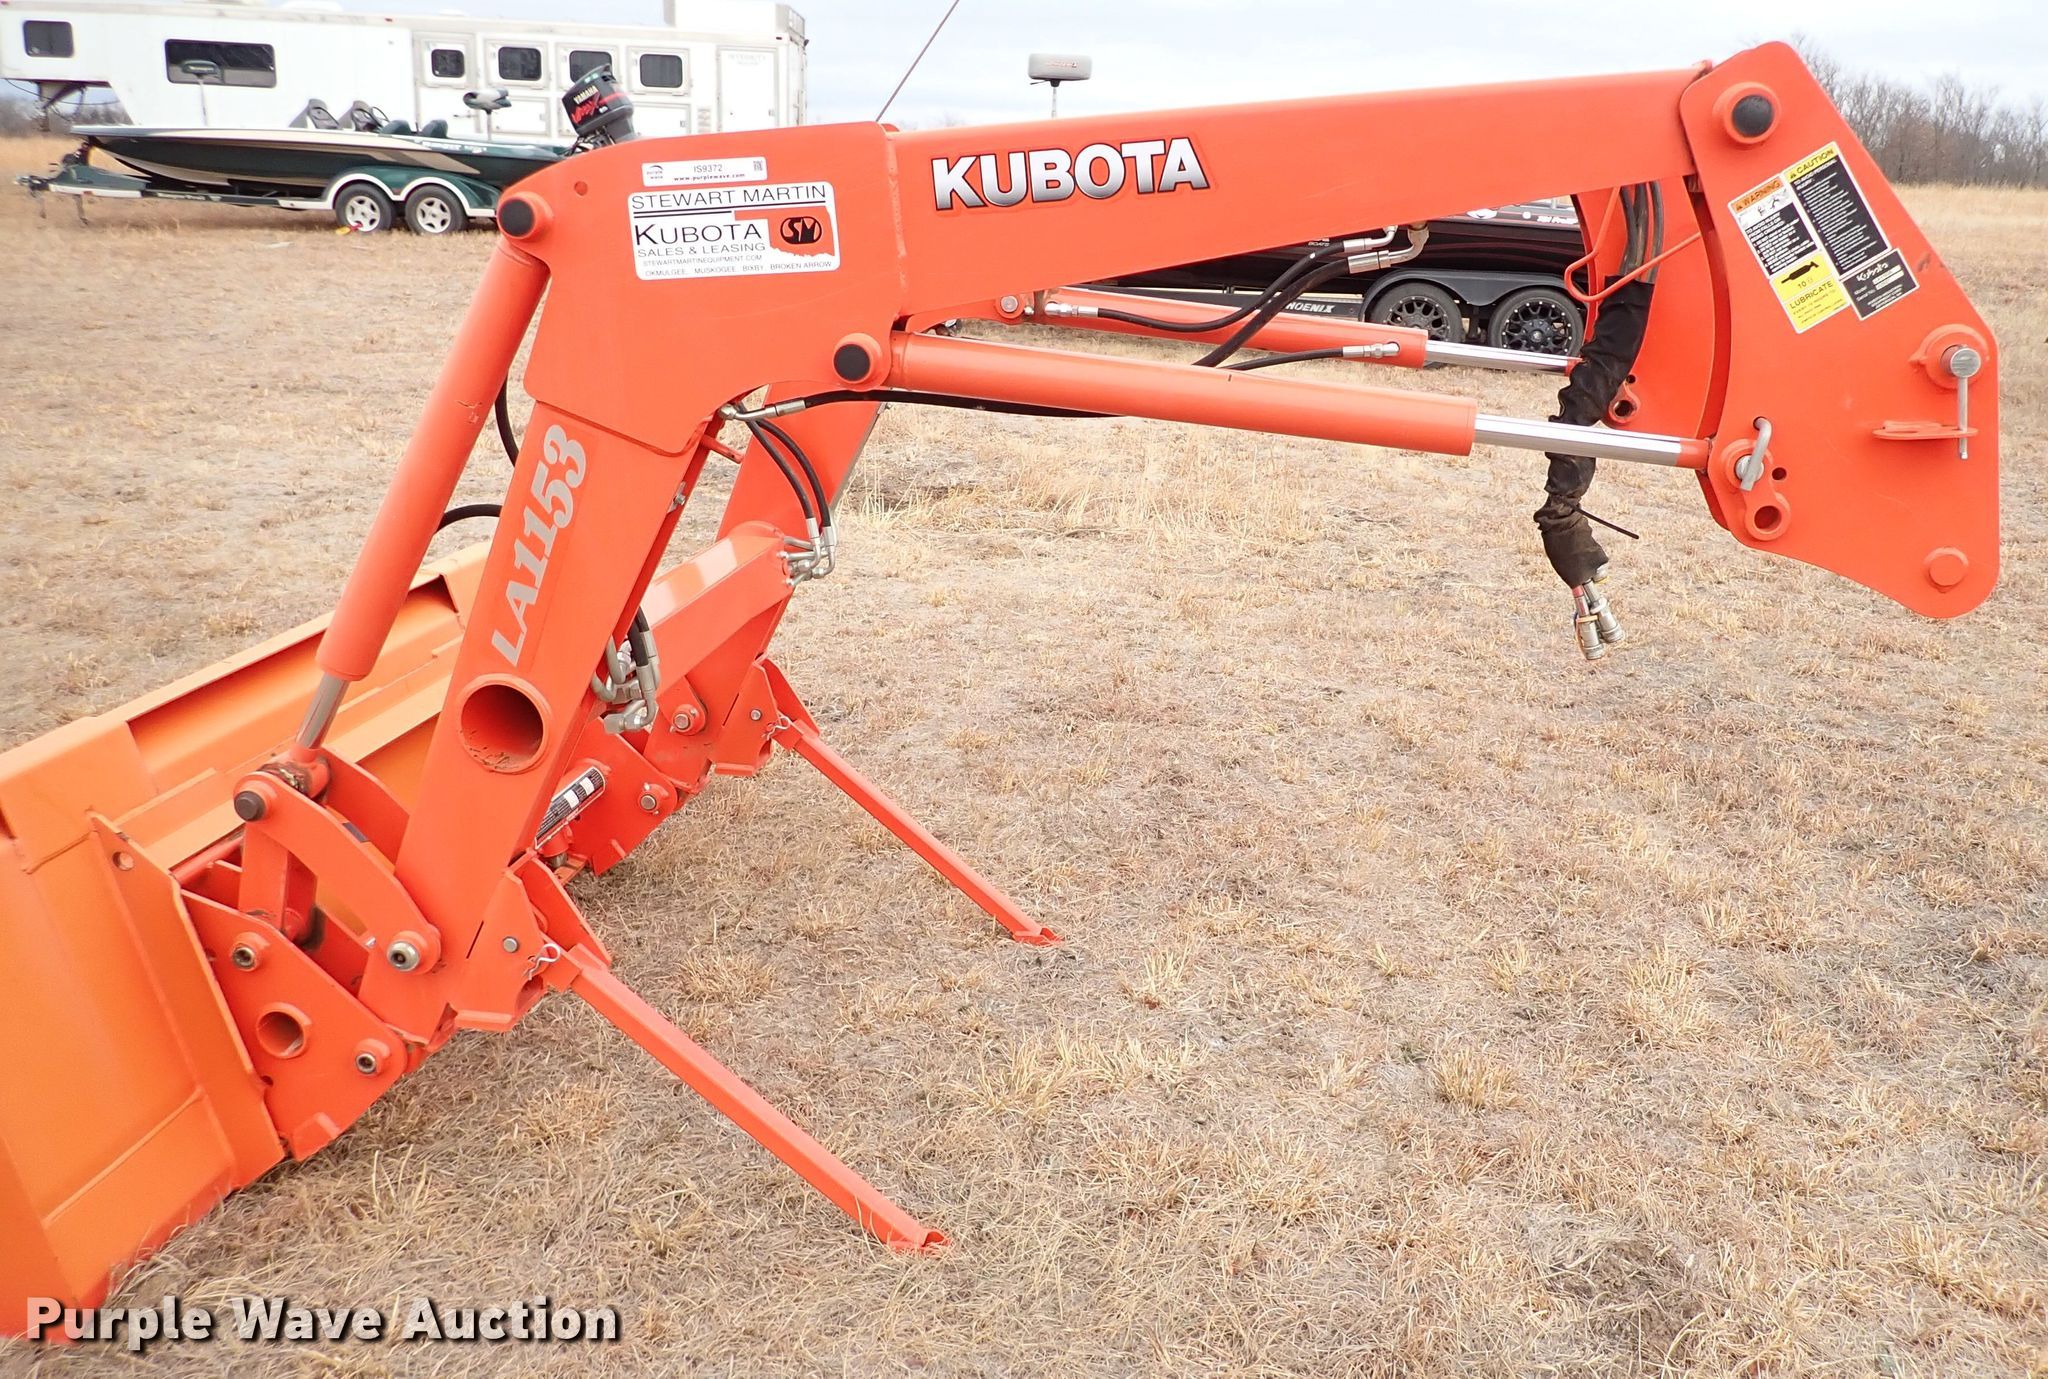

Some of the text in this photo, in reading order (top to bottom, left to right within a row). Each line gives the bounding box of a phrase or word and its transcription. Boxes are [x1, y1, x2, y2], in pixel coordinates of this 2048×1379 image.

[573, 85, 599, 105] YAMAHA
[693, 164, 723, 173] IS9372
[1796, 149, 1834, 174] CAUTION
[674, 173, 746, 181] www.purplewave.com
[931, 137, 1210, 211] KUBOTA
[632, 185, 826, 209] STEWART MARTIN
[1743, 180, 1780, 206] WARNING
[634, 223, 762, 246] KUBOTA
[637, 242, 766, 258] SALES & LEASING
[770, 262, 802, 271] BROKEN
[803, 260, 832, 269] ARROW
[1789, 280, 1833, 309] LUBRICATE
[1284, 301, 1335, 313] HOENIX
[491, 424, 587, 667] LA1153
